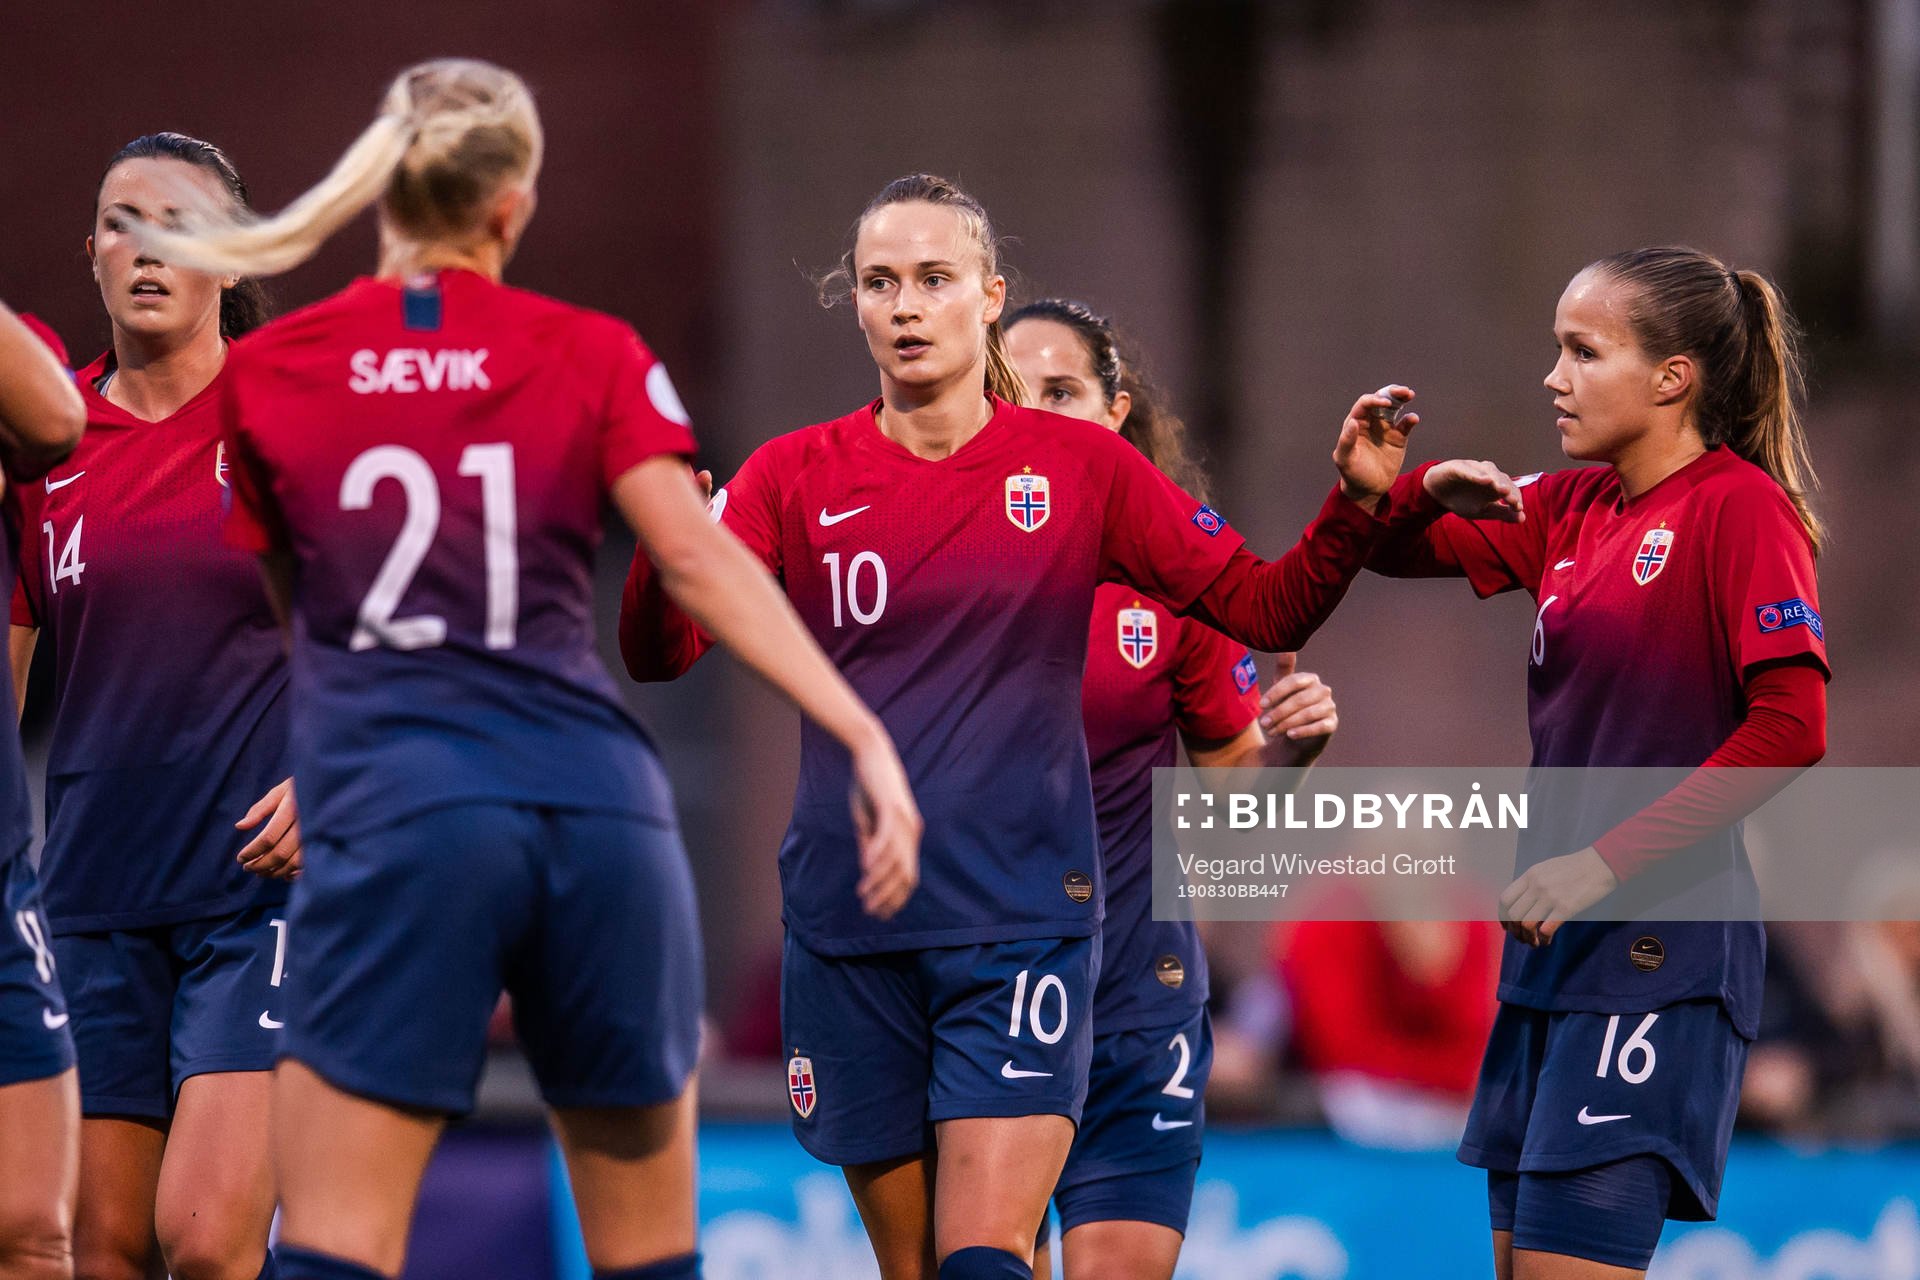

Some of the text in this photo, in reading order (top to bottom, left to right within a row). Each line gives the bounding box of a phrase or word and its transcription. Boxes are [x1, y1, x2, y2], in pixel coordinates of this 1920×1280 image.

[349, 348, 491, 394] SÆVIK
[43, 514, 86, 594] 14
[339, 442, 518, 651] 21
[822, 550, 888, 628] 10
[1530, 594, 1559, 666] 6
[269, 918, 289, 988] 1
[1008, 969, 1069, 1045] 10
[1161, 1032, 1195, 1099] 2
[1596, 1012, 1660, 1085] 16
